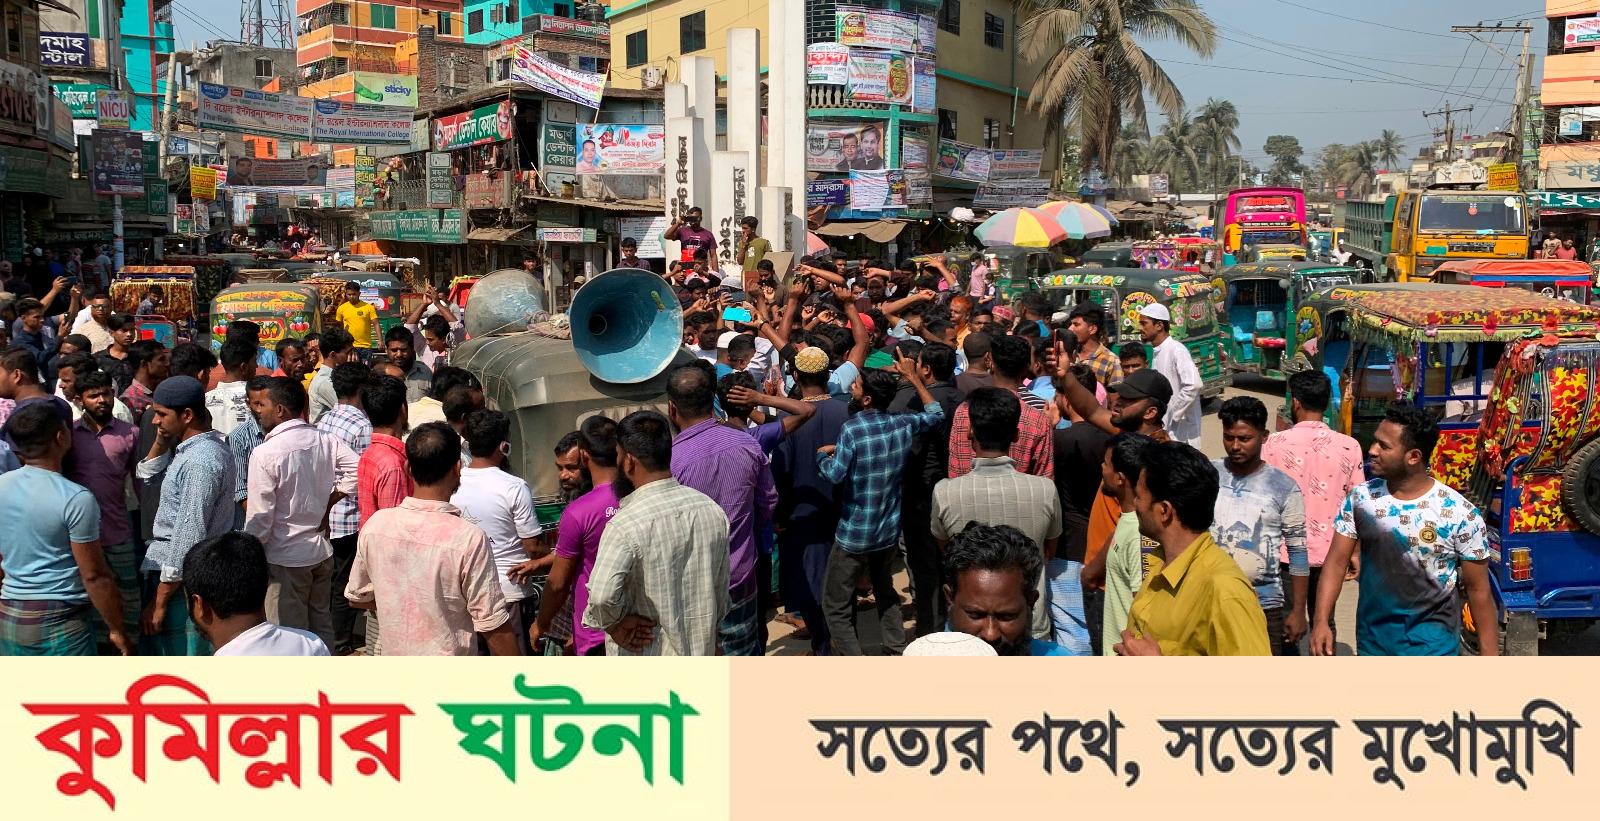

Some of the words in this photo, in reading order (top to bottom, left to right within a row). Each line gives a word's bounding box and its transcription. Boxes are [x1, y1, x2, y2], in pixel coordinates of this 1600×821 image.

[384, 84, 411, 96] sticky
[100, 101, 128, 118] NICU
[316, 127, 328, 135] The
[330, 128, 347, 136] Royal
[348, 128, 387, 137] International
[387, 130, 410, 139] College
